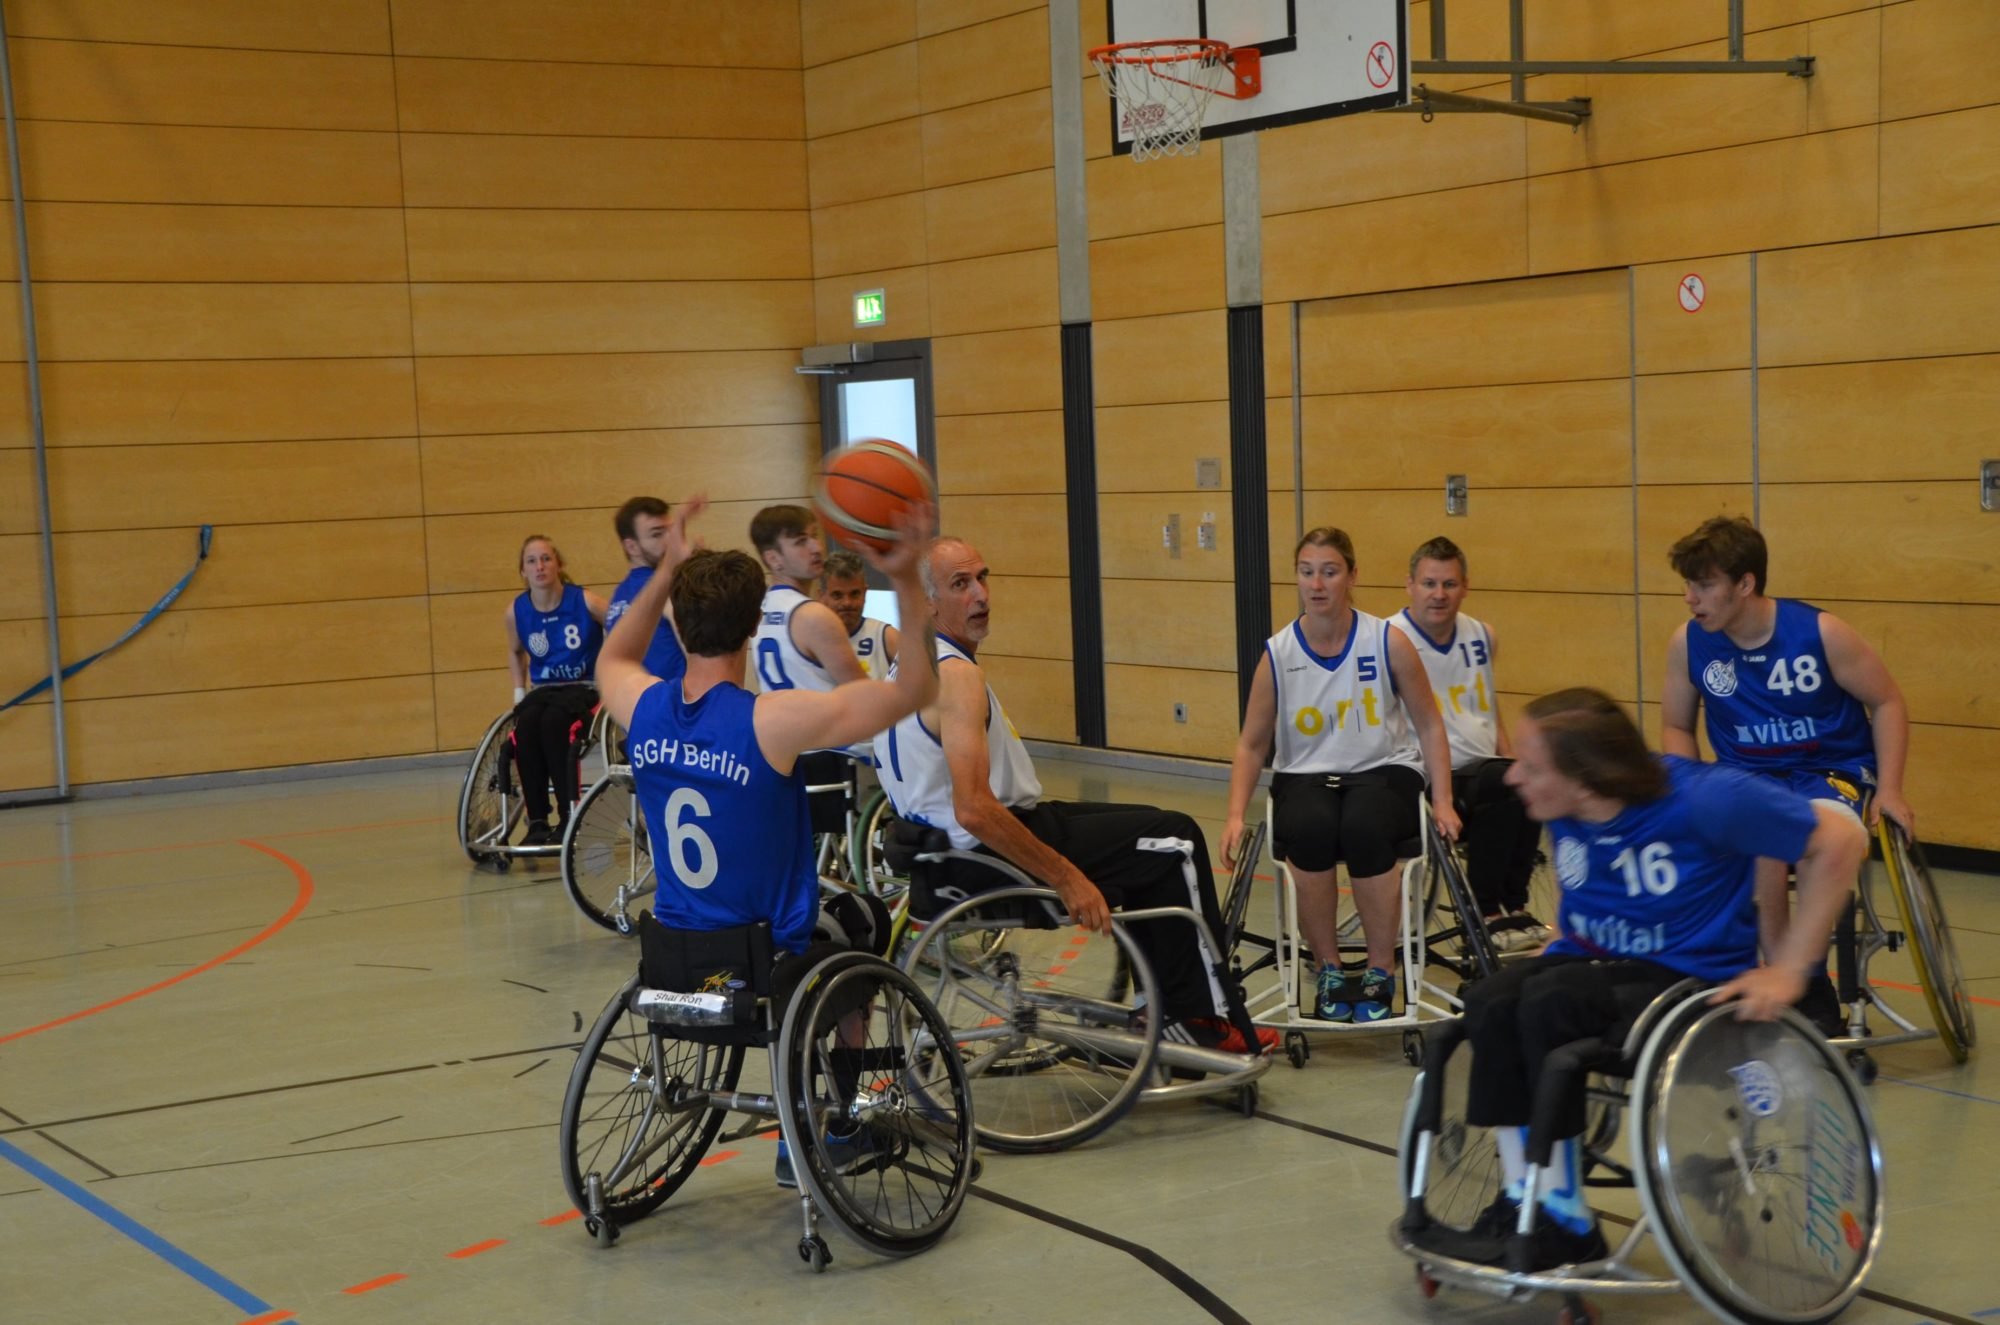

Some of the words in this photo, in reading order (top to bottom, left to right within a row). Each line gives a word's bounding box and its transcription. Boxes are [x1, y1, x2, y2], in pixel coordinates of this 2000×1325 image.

[564, 624, 581, 650] 8
[857, 637, 873, 656] 9
[1459, 640, 1488, 668] 13
[550, 660, 587, 679] vital
[1357, 655, 1377, 682] 5
[1766, 655, 1821, 695] 48
[1295, 688, 1381, 736] ort
[1752, 716, 1817, 745] vital
[633, 738, 679, 769] SGH
[683, 743, 750, 787] Berlin
[664, 787, 719, 889] 6
[1609, 841, 1678, 897] 16
[1588, 914, 1665, 955] vital
